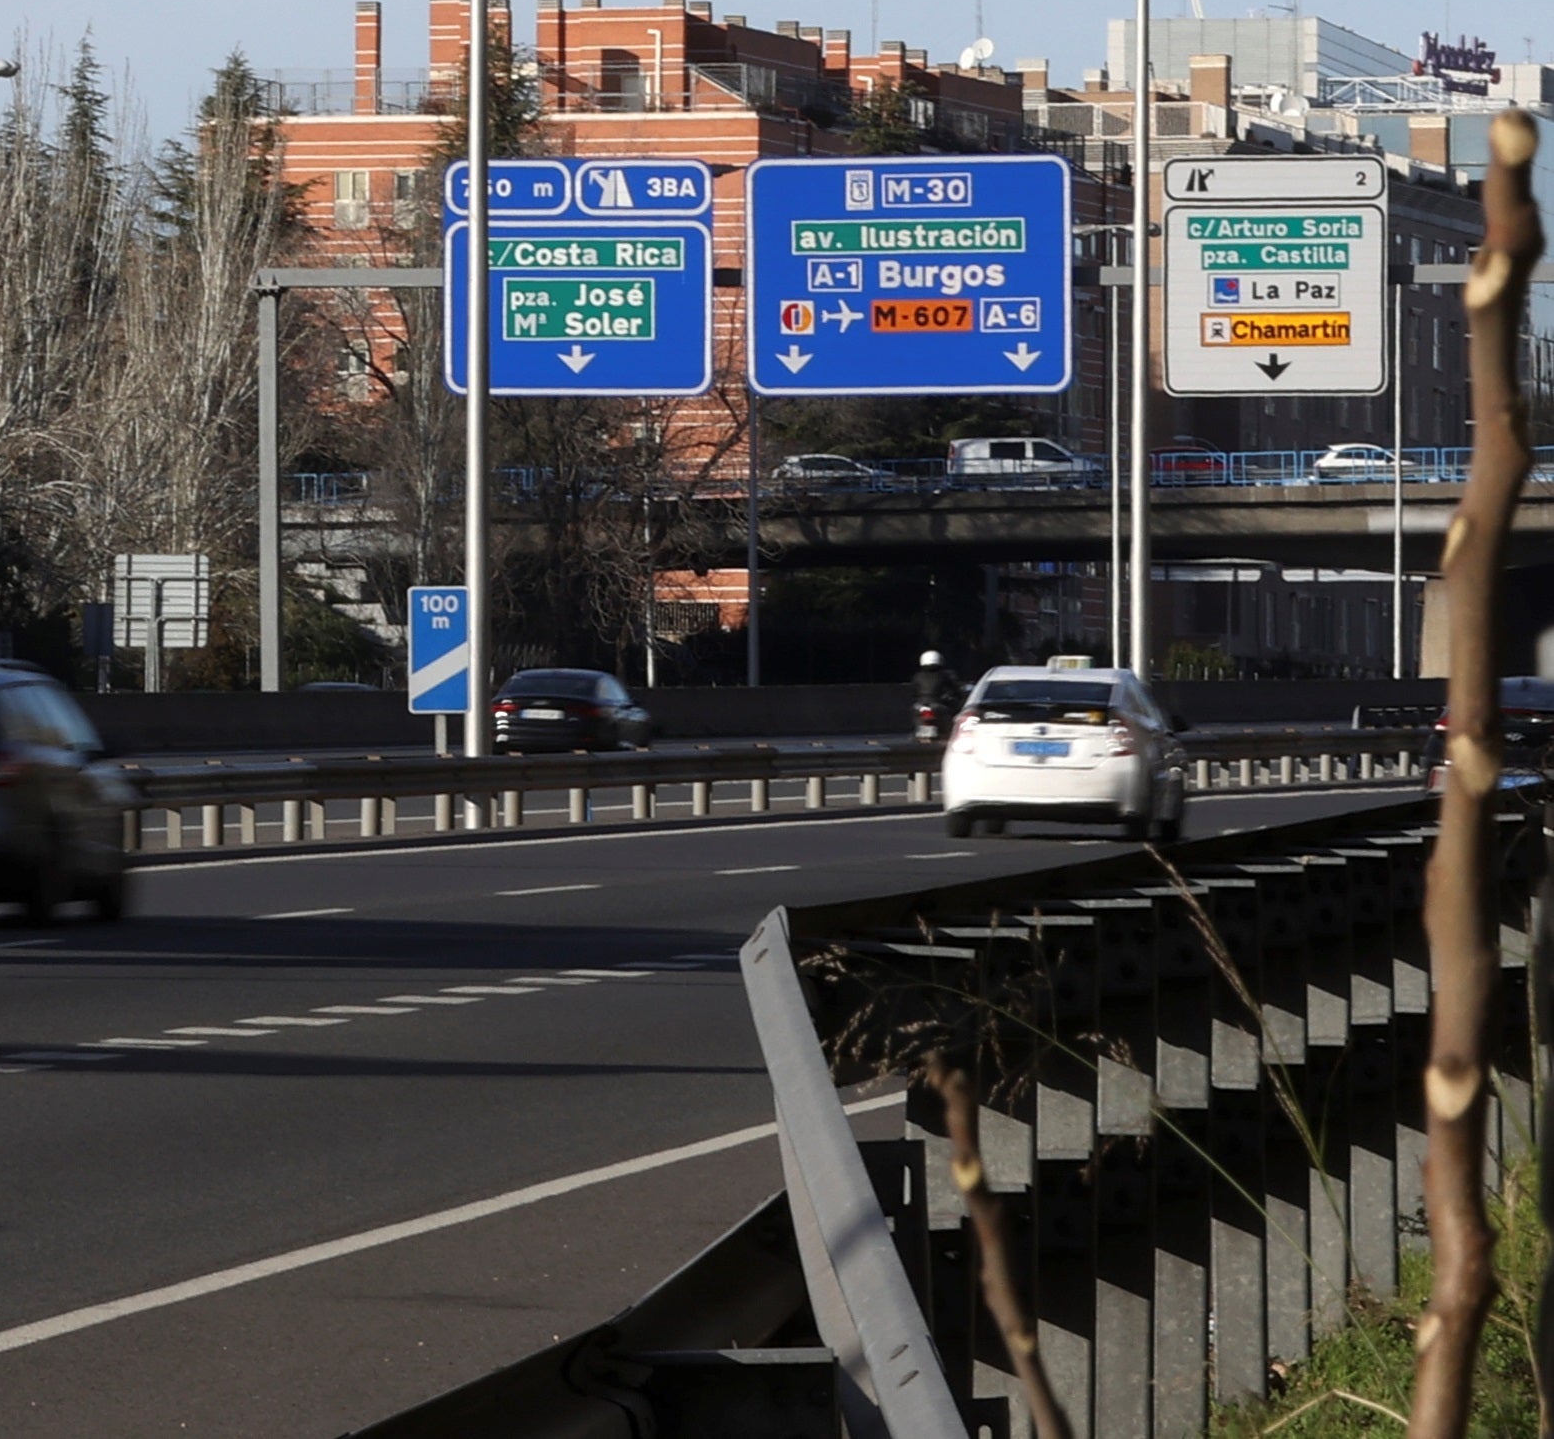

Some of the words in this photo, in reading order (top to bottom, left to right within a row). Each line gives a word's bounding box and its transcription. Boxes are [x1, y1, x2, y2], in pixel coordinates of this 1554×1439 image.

[533, 181, 554, 198] m
[646, 177, 697, 198] 3BA
[1355, 171, 1367, 187] 2
[887, 178, 966, 203] M-30
[799, 230, 843, 249] av.
[860, 222, 1018, 249] Ilustración
[1190, 219, 1289, 238] c/Arturo
[1302, 218, 1361, 237] Soria
[615, 241, 678, 266] Rica
[1203, 249, 1248, 268] pza.
[1261, 246, 1347, 264] Castilla
[813, 263, 859, 287] A-1
[879, 260, 1006, 295] Burgos
[510, 290, 558, 311] pza.
[574, 282, 645, 307] José
[1252, 281, 1280, 300] La
[1295, 280, 1336, 300] Paz
[564, 311, 644, 336] Soler
[873, 305, 969, 328] M-607
[986, 304, 1036, 327] A-6
[1232, 319, 1350, 340] Chamartín
[420, 594, 459, 613] 100
[431, 615, 450, 629] m
